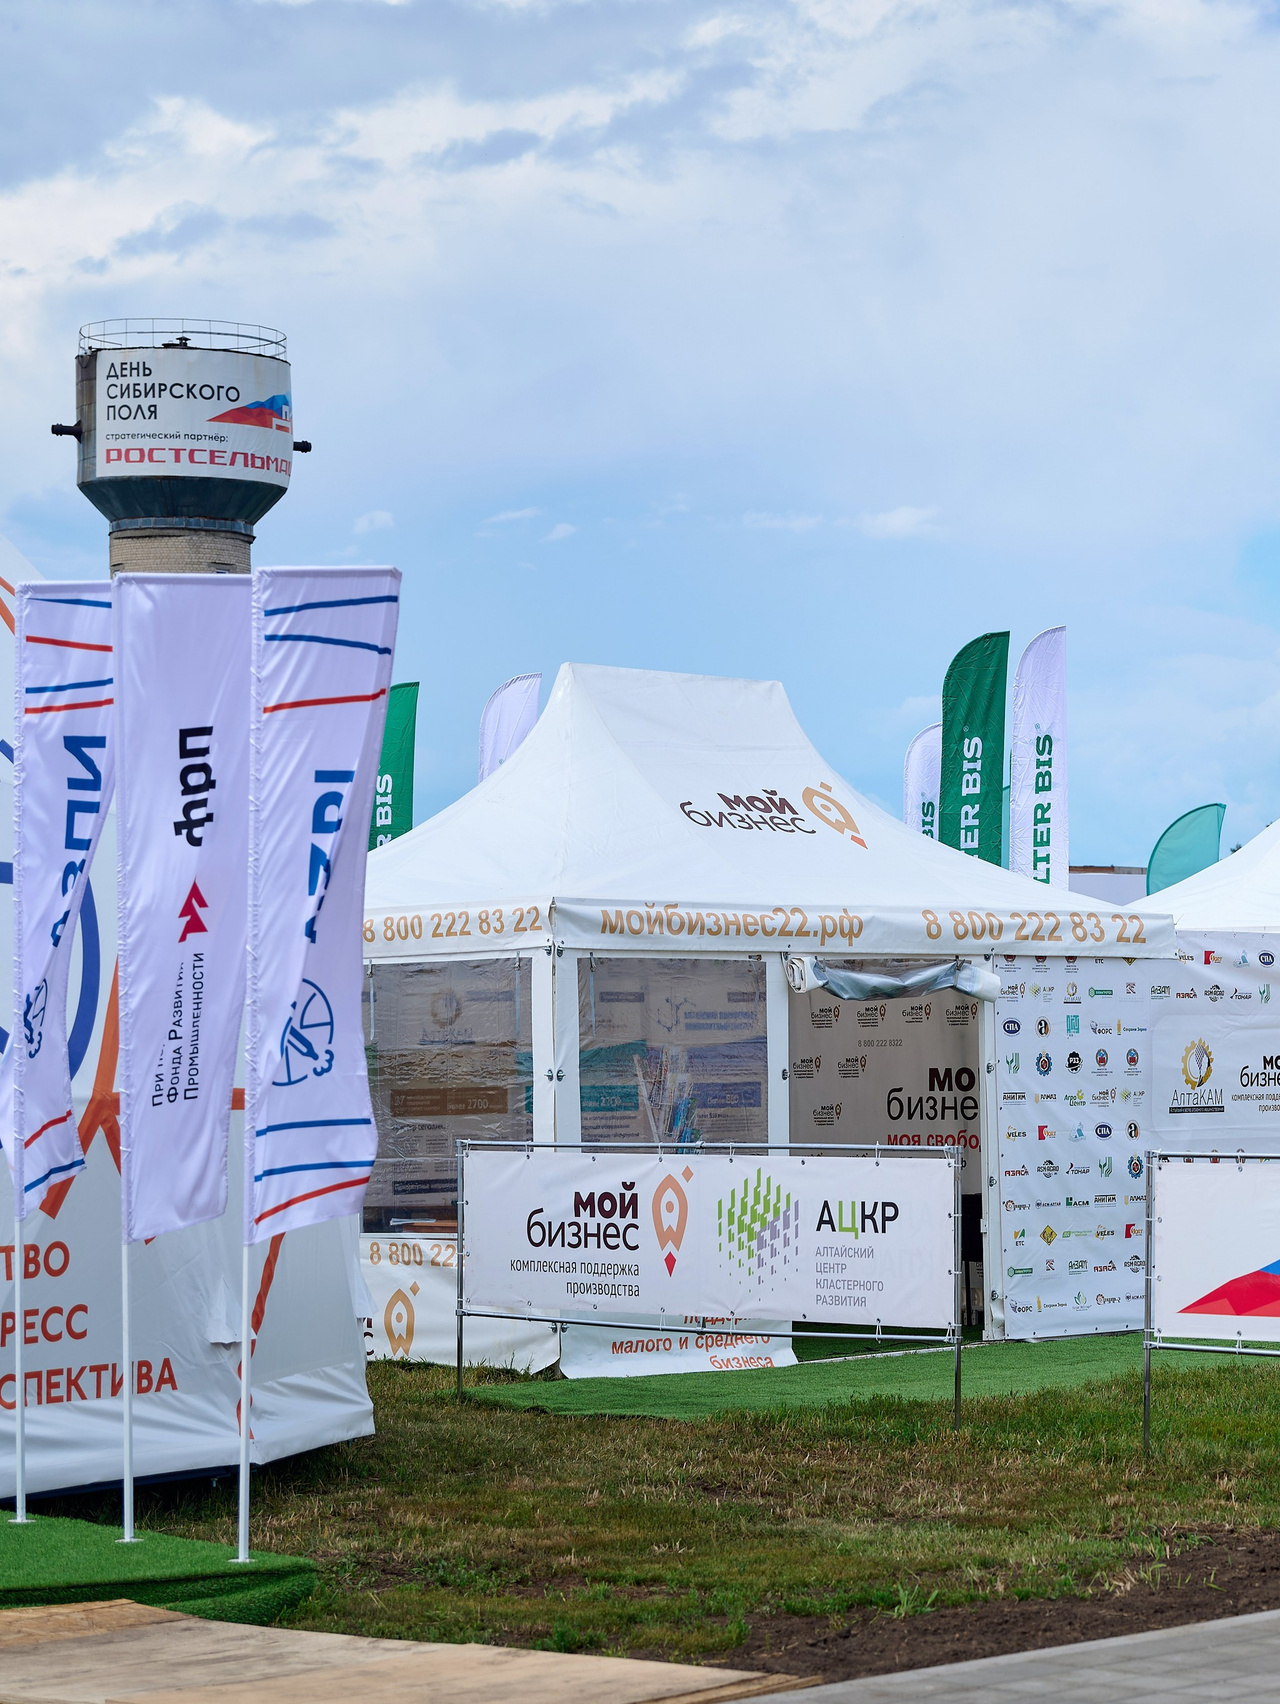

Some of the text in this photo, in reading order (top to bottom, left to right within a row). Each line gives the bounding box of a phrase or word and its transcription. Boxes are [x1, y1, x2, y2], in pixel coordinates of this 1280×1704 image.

[106, 361, 152, 380] ДЕНЬ
[106, 382, 240, 402] СИБИРСКОГО
[106, 404, 158, 421] ПОЛЯ
[105, 431, 229, 443] стратегический партнёр:
[961, 736, 983, 797] BIS
[1035, 734, 1053, 794] BIS
[375, 773, 393, 827] BIS
[717, 789, 800, 815] мой
[679, 801, 817, 835] бизнес
[362, 905, 543, 943] 8 800 222 83 22
[600, 902, 864, 947] мойбизнес22.рф
[921, 909, 1147, 944] 8 800 222 83 22
[928, 1067, 980, 1092] мо
[1171, 1088, 1223, 1106] АлтаКАМ
[926, 1129, 982, 1153] свобо
[573, 1181, 639, 1219] мой
[527, 1207, 640, 1251] бизнес
[816, 1200, 899, 1240] АЦКР
[369, 1241, 465, 1267] 8 800 22
[815, 1245, 874, 1259] АЛТАЙСКИЙ
[510, 1259, 640, 1280] комплексная поддержка
[816, 1262, 847, 1275] ЦЕНТР
[566, 1281, 640, 1298] производства
[816, 1278, 884, 1292] КЛАСТЕРНОГО
[816, 1294, 867, 1307] РАЗВИТИЯ
[611, 1337, 672, 1355] малого
[679, 1336, 689, 1350] и
[709, 1355, 774, 1370] бизнеса
